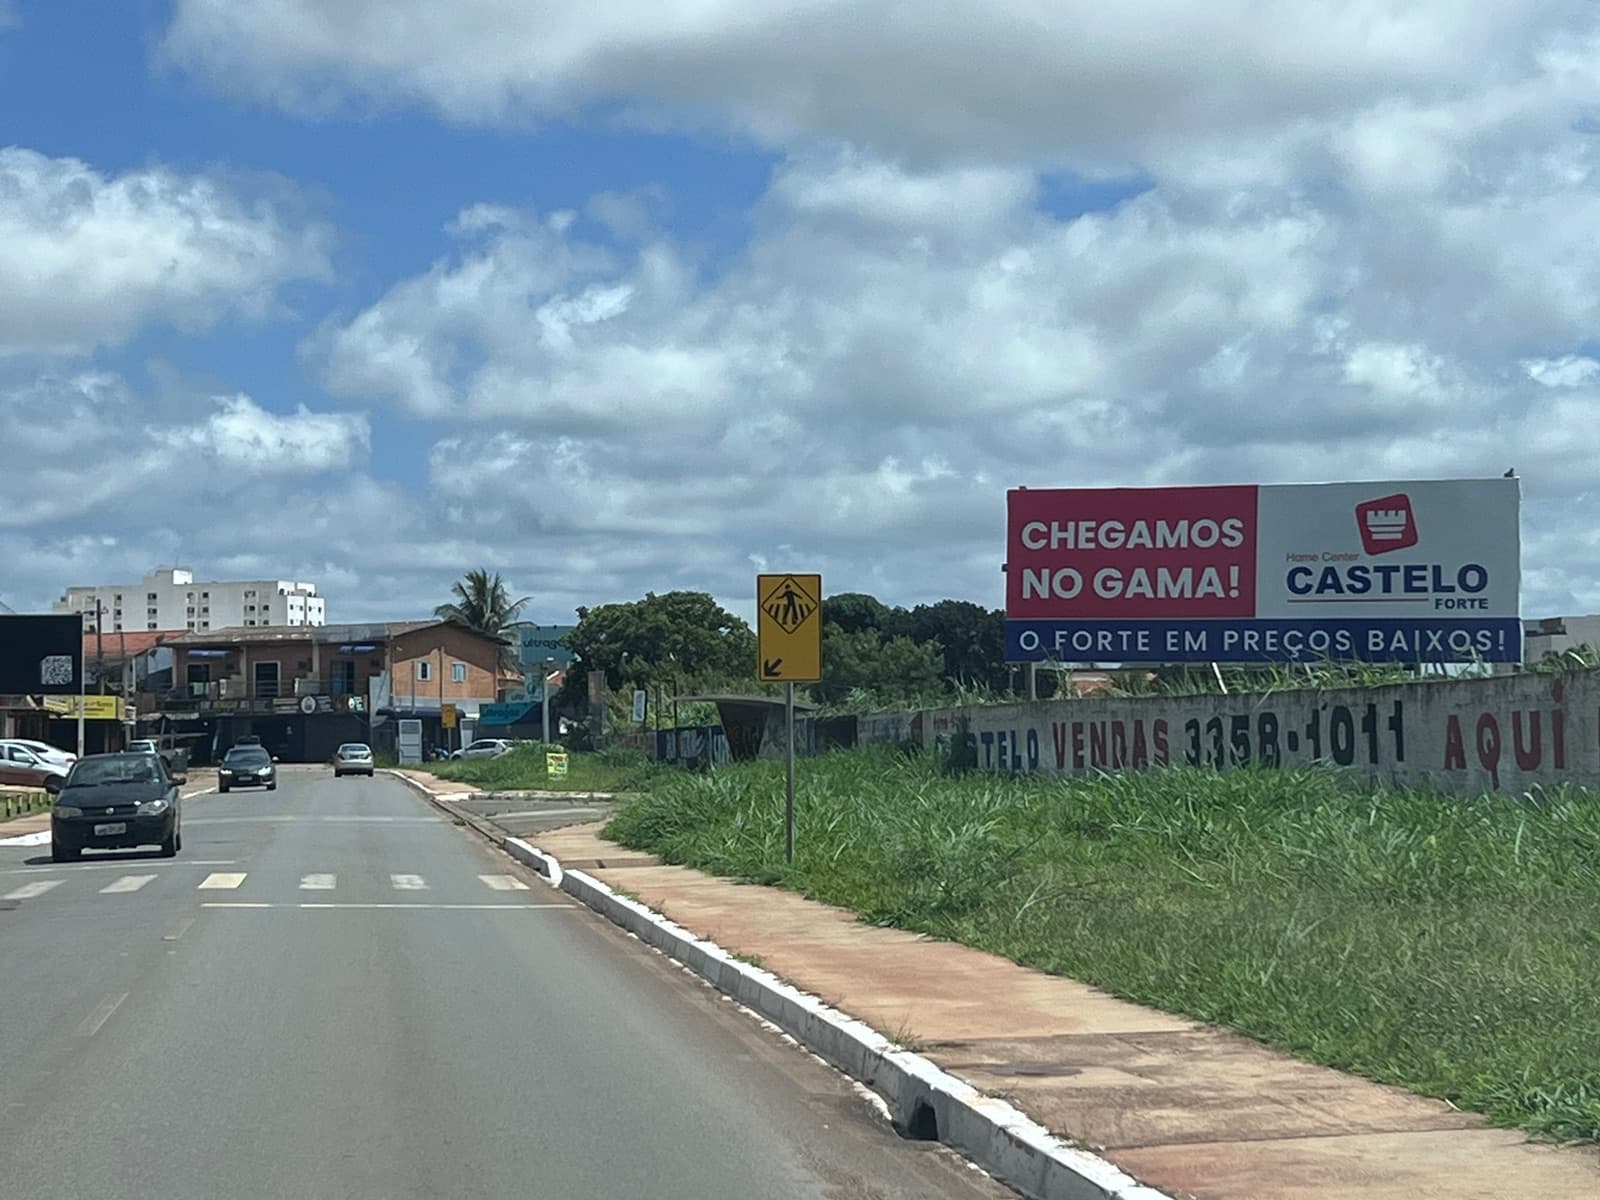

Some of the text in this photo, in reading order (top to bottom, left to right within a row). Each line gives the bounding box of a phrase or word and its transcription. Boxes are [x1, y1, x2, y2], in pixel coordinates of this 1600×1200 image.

[1021, 518, 1244, 550] CHEGAMOS
[1286, 551, 1361, 562] Home Center
[1022, 565, 1241, 599] NO GAMA!
[1287, 564, 1489, 595] CASTELO
[1435, 598, 1489, 610] FORTE
[1019, 629, 1506, 658] O FORTE EM PREÇOS BAIXOS!
[1052, 718, 1169, 770] VENDAS
